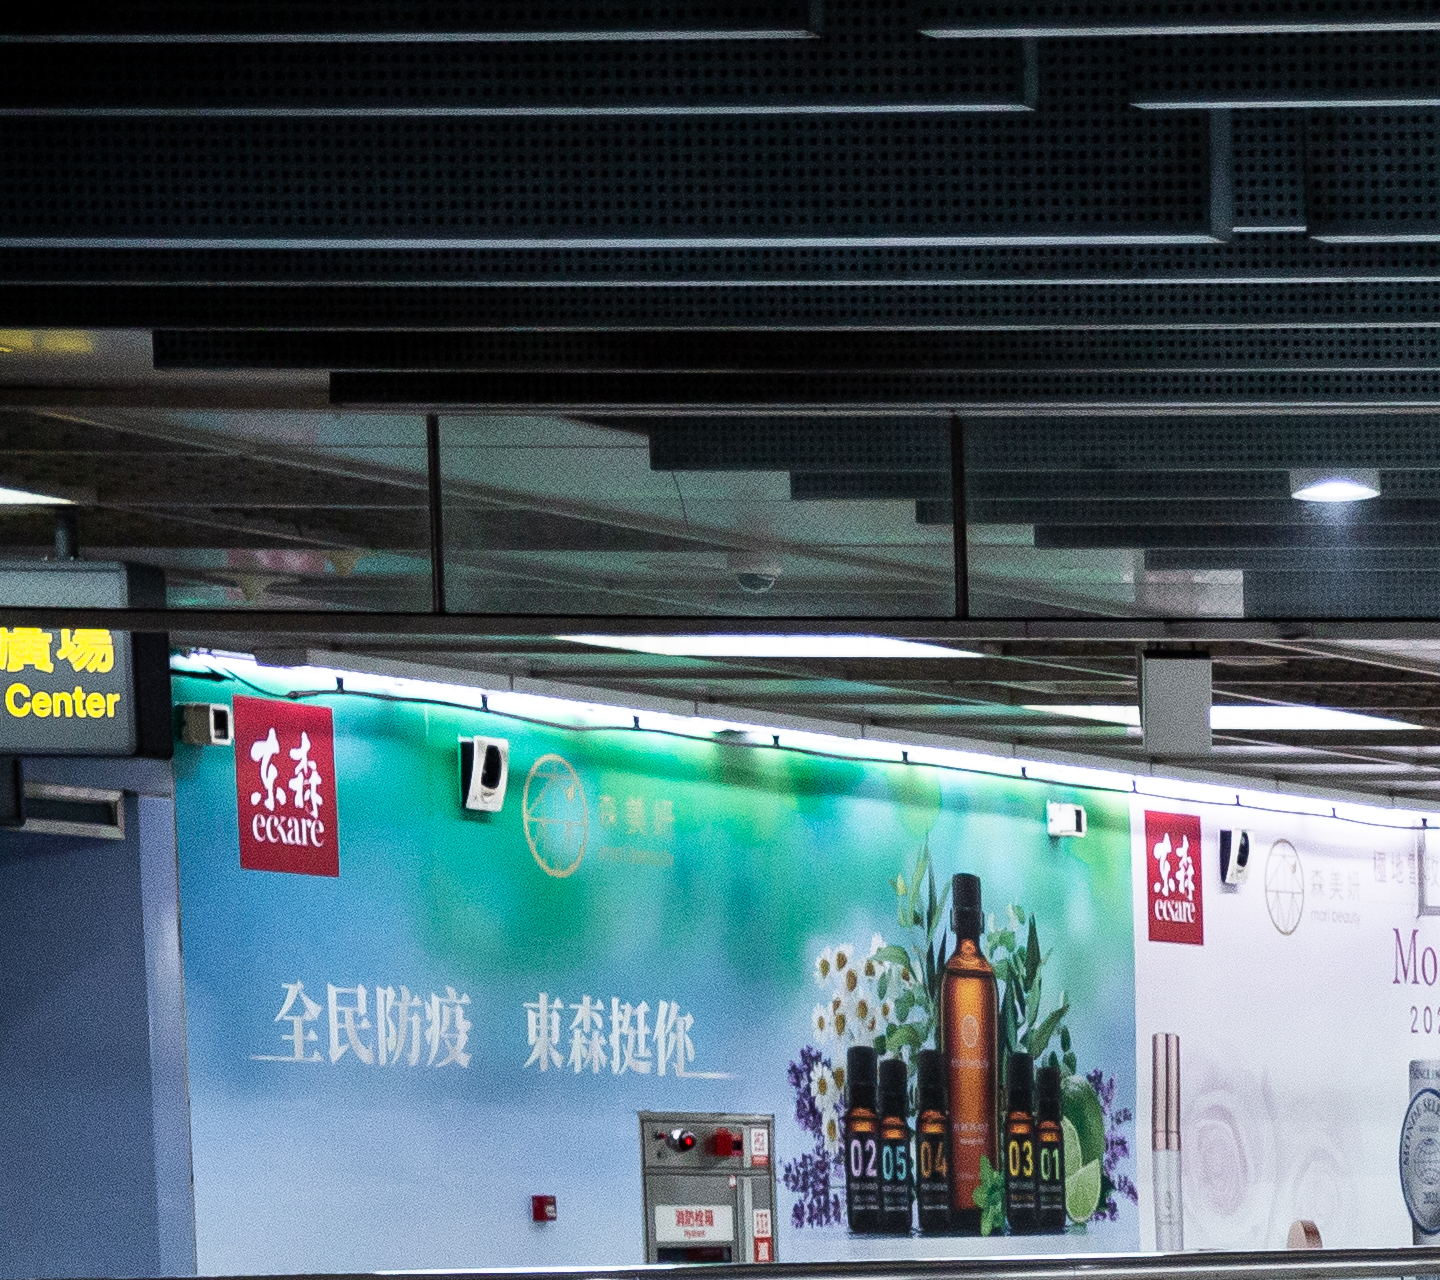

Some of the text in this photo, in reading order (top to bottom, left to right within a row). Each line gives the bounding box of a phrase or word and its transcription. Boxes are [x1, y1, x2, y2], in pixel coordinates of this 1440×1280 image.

[5, 683, 120, 718] Center
[250, 981, 720, 1078] 全民防疫 東森挺你
[850, 1139, 878, 1177] 02
[882, 1145, 906, 1180] 05
[921, 1141, 947, 1178] 04
[1008, 1140, 1034, 1177] 03
[1040, 1148, 1060, 1180] 01
